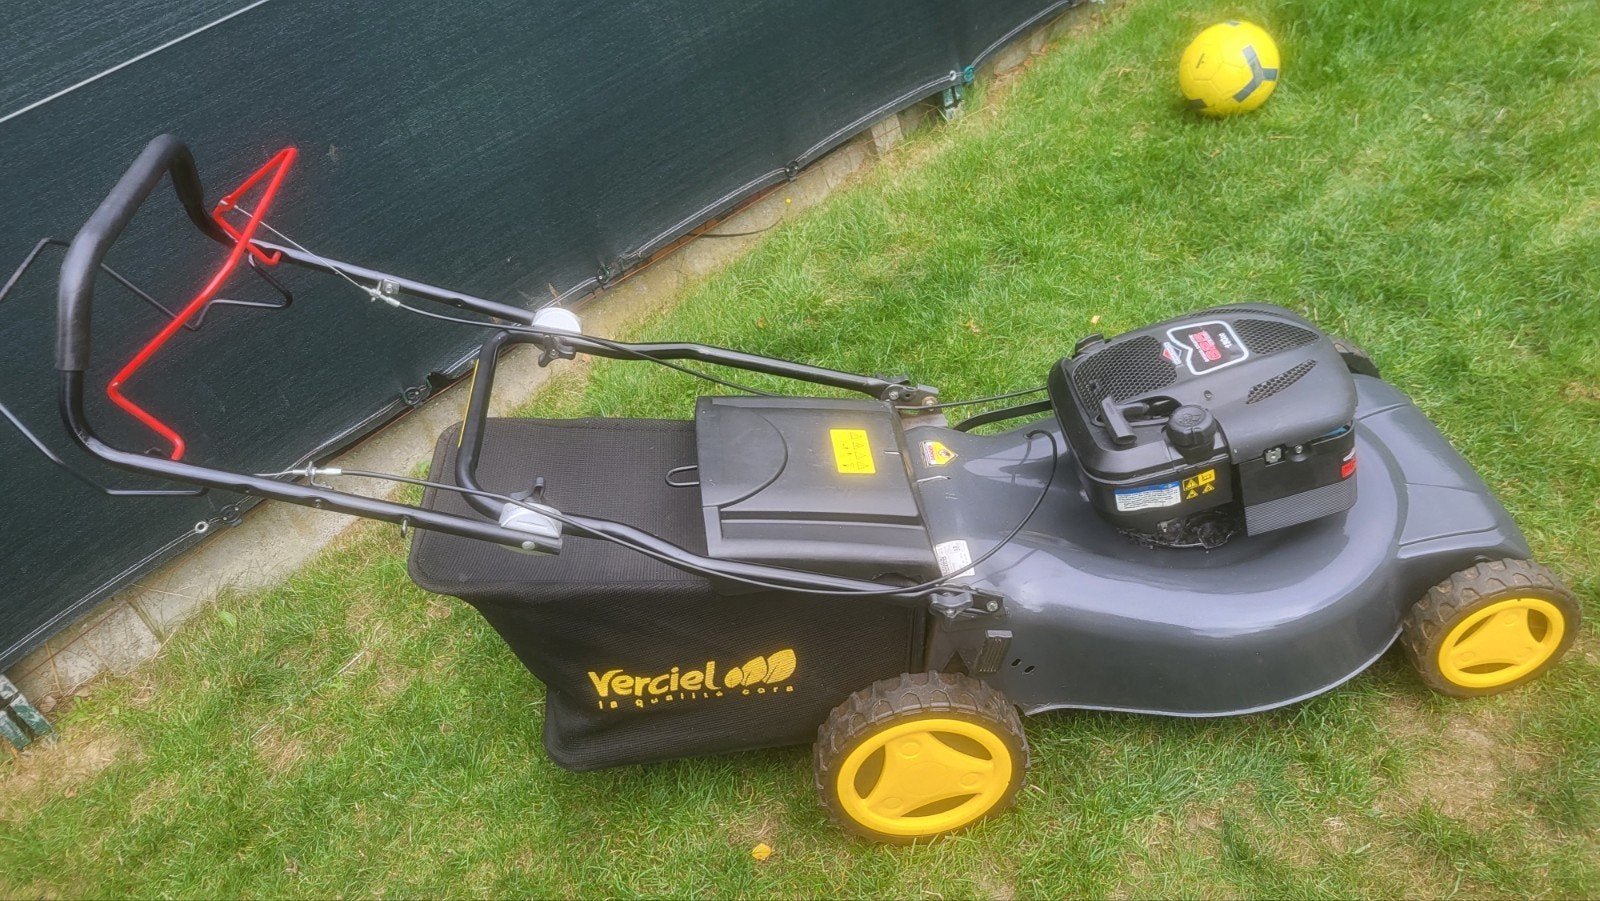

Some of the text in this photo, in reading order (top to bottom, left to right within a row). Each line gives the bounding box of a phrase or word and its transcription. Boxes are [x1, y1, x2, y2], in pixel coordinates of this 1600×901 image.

[588, 660, 721, 697] Verciel
[598, 700, 618, 709] la
[742, 685, 793, 695] cora
